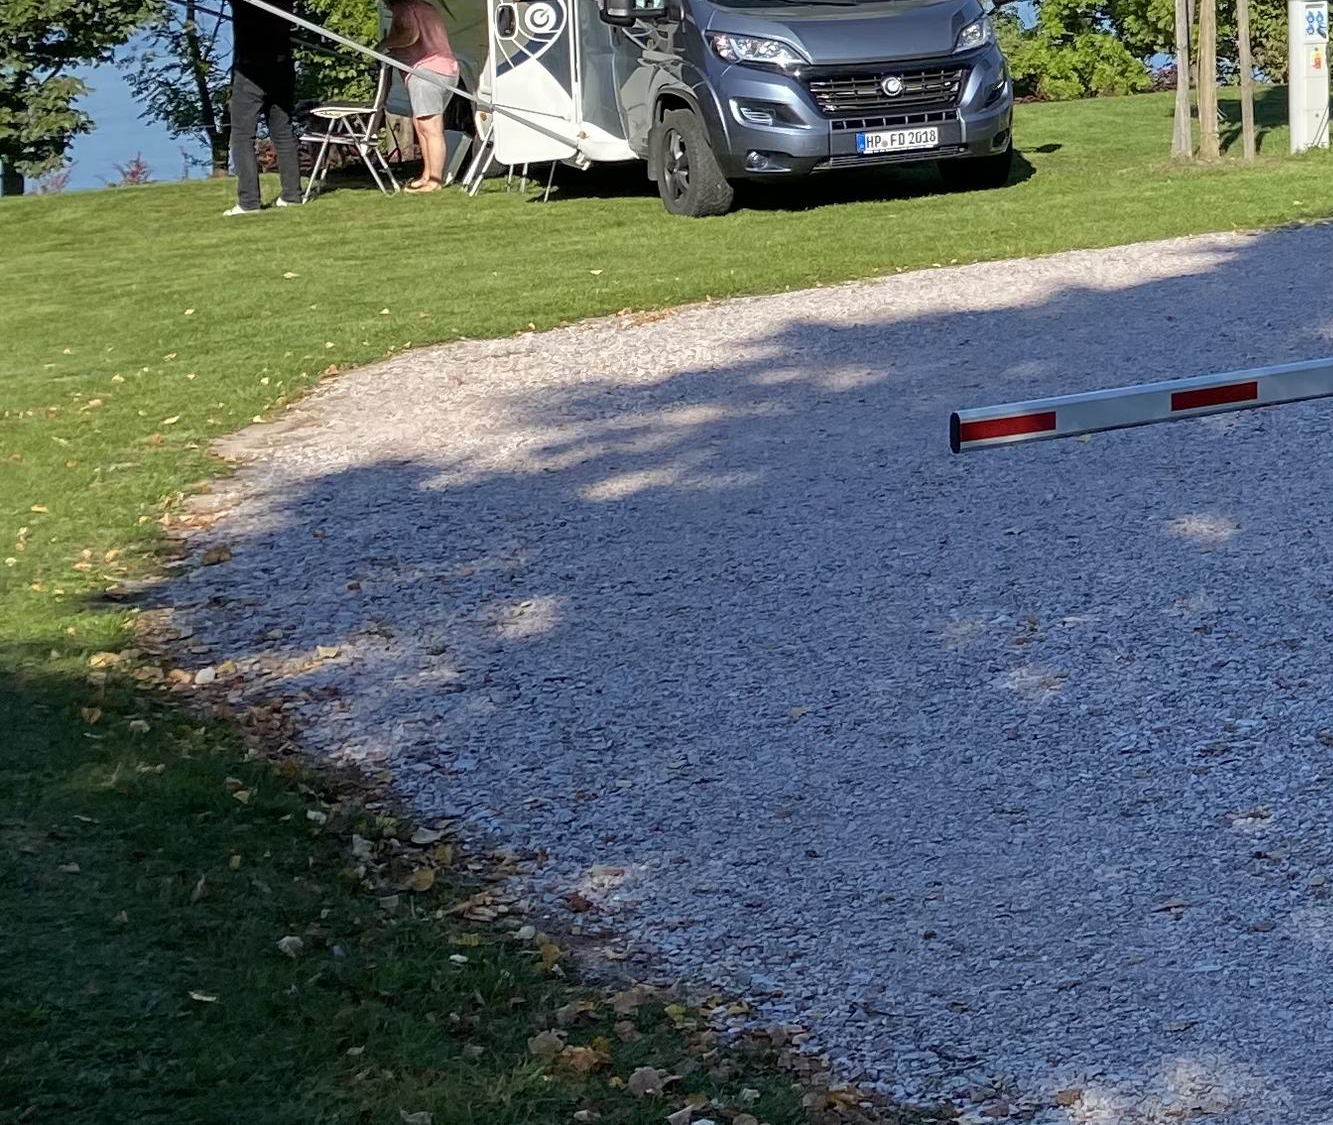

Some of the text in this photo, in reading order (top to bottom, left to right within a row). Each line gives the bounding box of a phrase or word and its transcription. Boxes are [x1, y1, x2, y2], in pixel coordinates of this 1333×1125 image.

[867, 130, 936, 148] HP FD 2018
